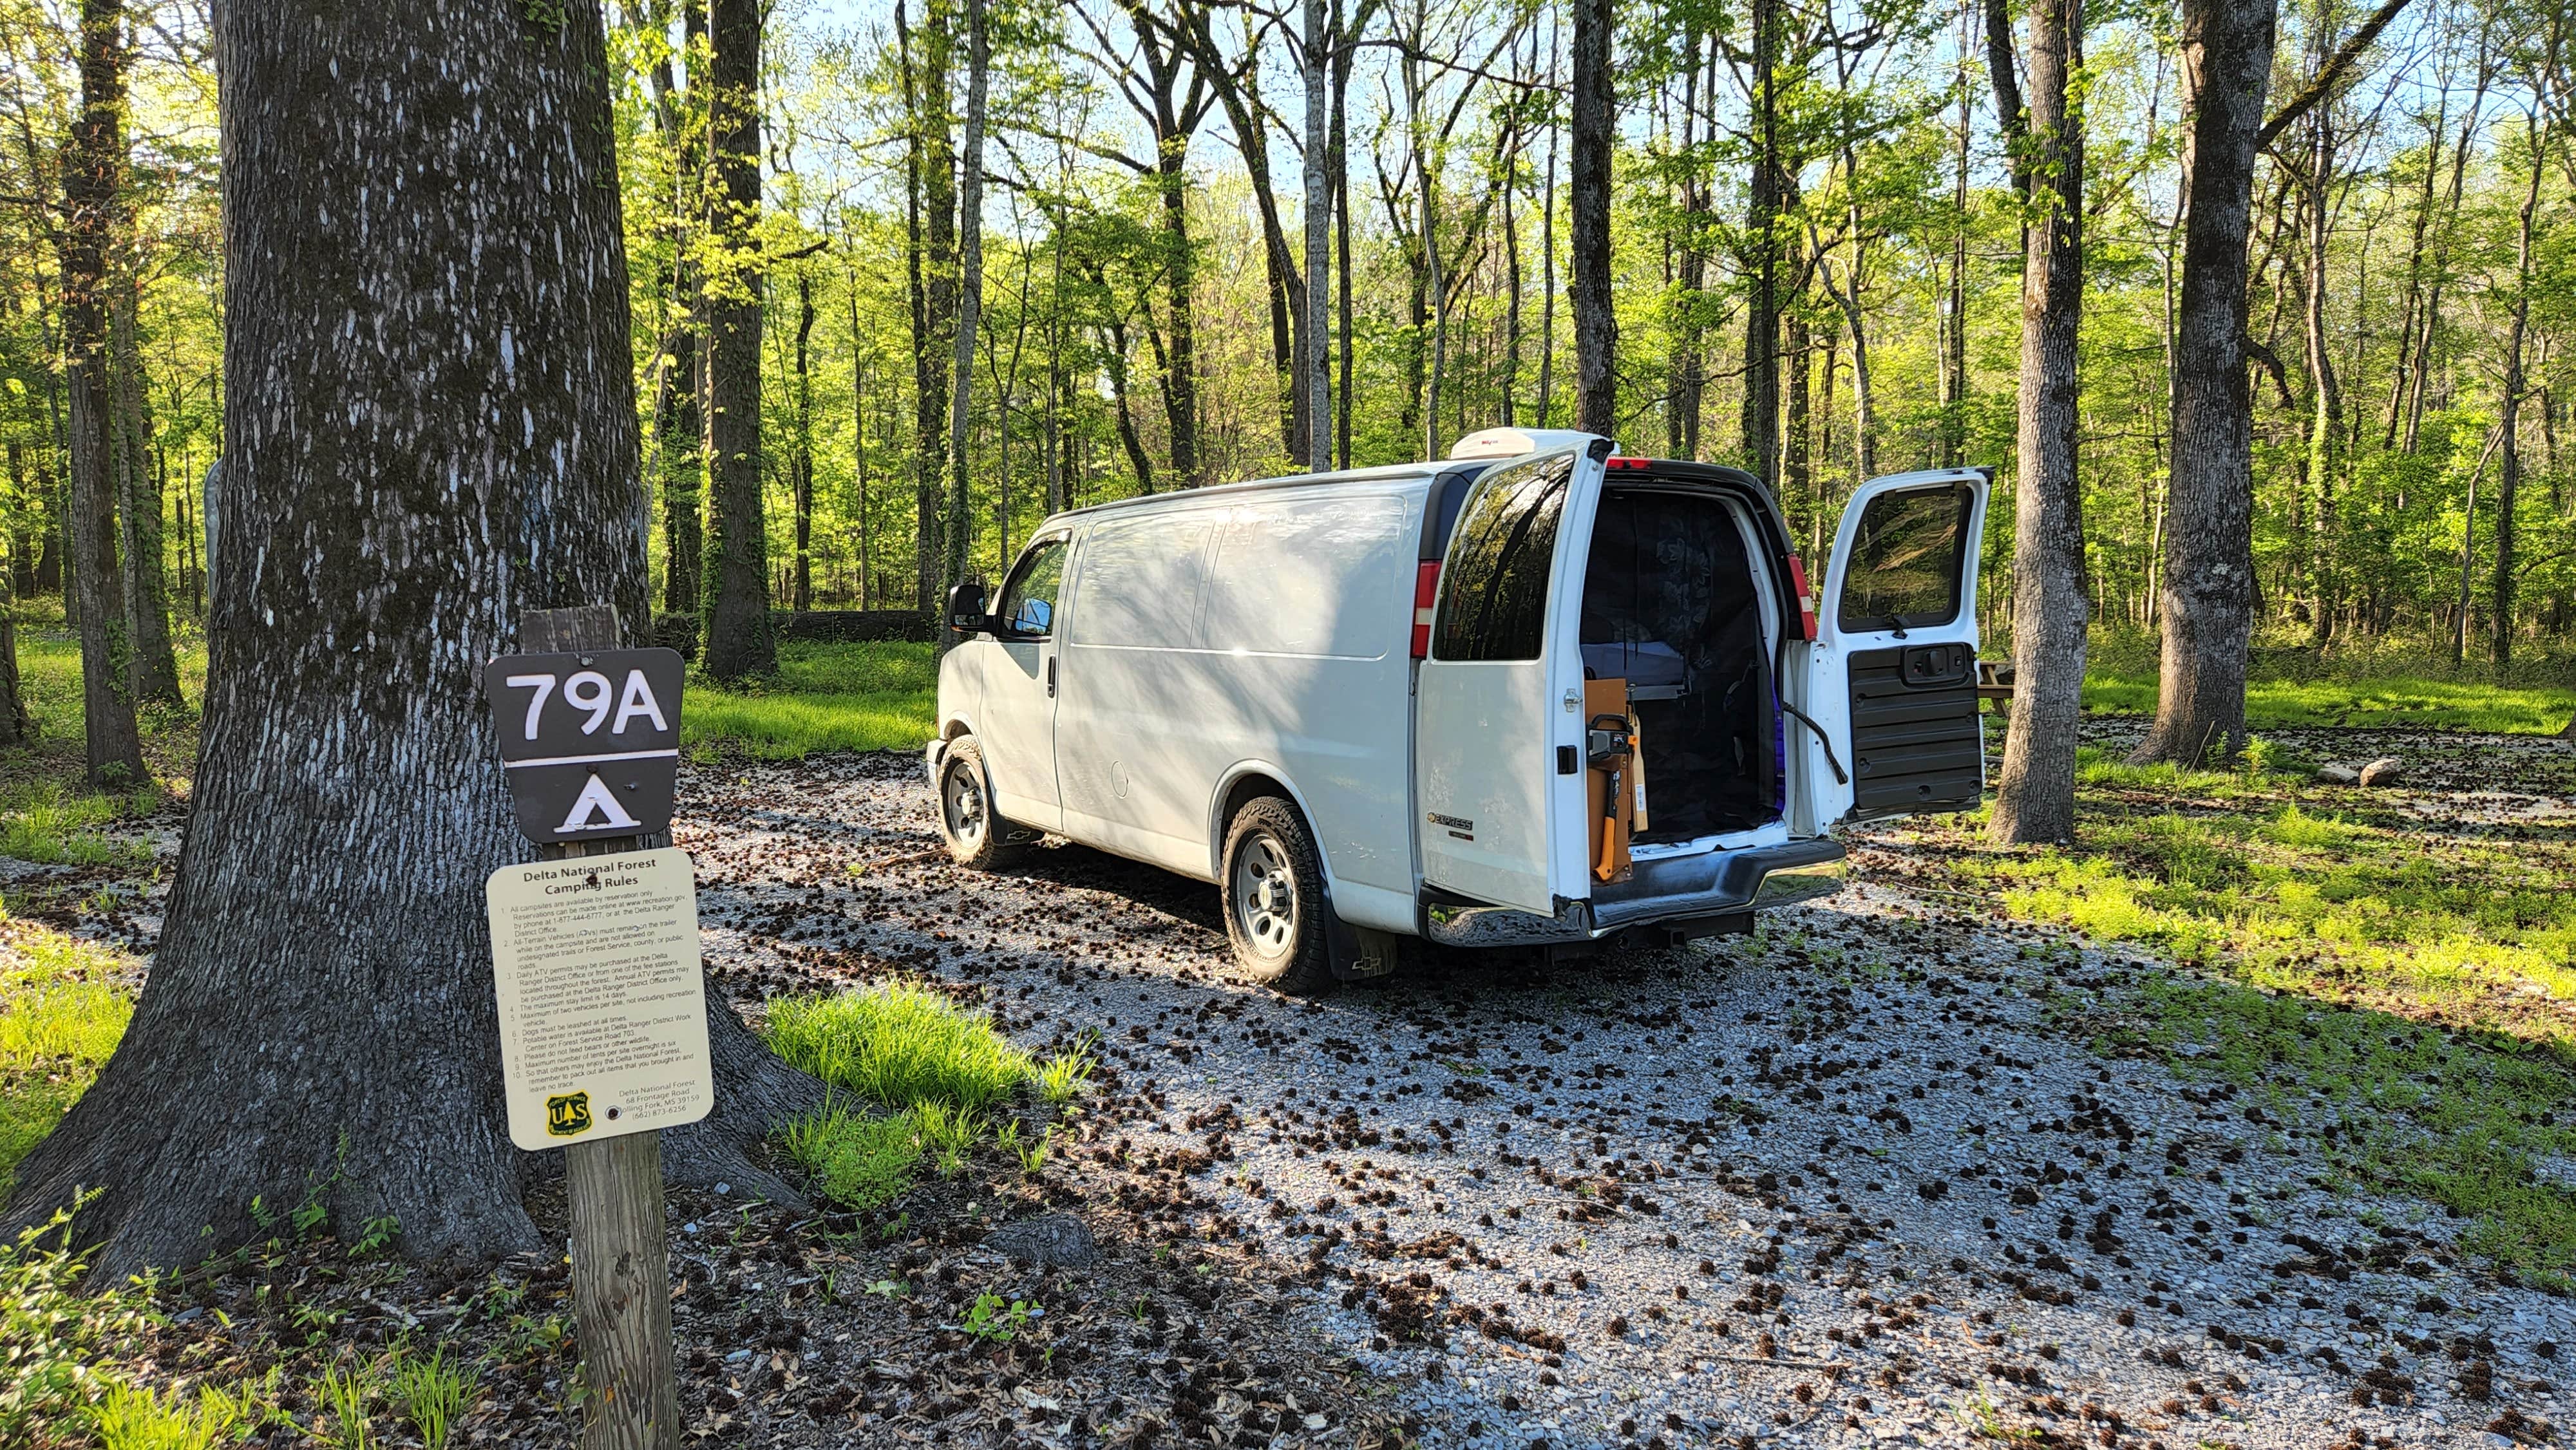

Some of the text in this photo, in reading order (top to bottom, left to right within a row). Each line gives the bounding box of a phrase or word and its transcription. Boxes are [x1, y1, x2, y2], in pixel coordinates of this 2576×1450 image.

[506, 669, 668, 740] 79A
[1435, 814, 1472, 830] EXPRESS
[524, 860, 656, 881] Delta National Forest
[605, 876, 638, 887] Rules
[520, 903, 552, 912] campsites
[566, 898, 593, 906] available
[605, 892, 638, 901] reservation
[513, 911, 554, 920] Reservations
[517, 951, 559, 962] undesignated
[586, 945, 606, 953] Forest
[665, 935, 683, 943] public
[550, 966, 573, 975] permits
[600, 958, 631, 968] purchased
[520, 986, 543, 995] located
[545, 981, 578, 991] throughout
[614, 973, 636, 981] Annual
[652, 968, 675, 977] permits
[545, 975, 566, 983] District
[531, 992, 564, 1003] purchased
[638, 994, 665, 1003] including
[666, 989, 696, 998] recreation
[523, 1036, 547, 1044] Potable
[574, 1028, 601, 1036] available
[653, 1016, 674, 1024] District
[632, 1043, 659, 1052] overnight
[634, 1050, 658, 1060] National
[529, 1075, 561, 1085] remember
[571, 1070, 585, 1079] pack
[651, 1057, 674, 1066] brought
[641, 1082, 671, 1093] National
[673, 1080, 695, 1088] Forest
[637, 1093, 669, 1102] Frontage
[672, 1088, 690, 1097] Road
[620, 1106, 643, 1115] olling
